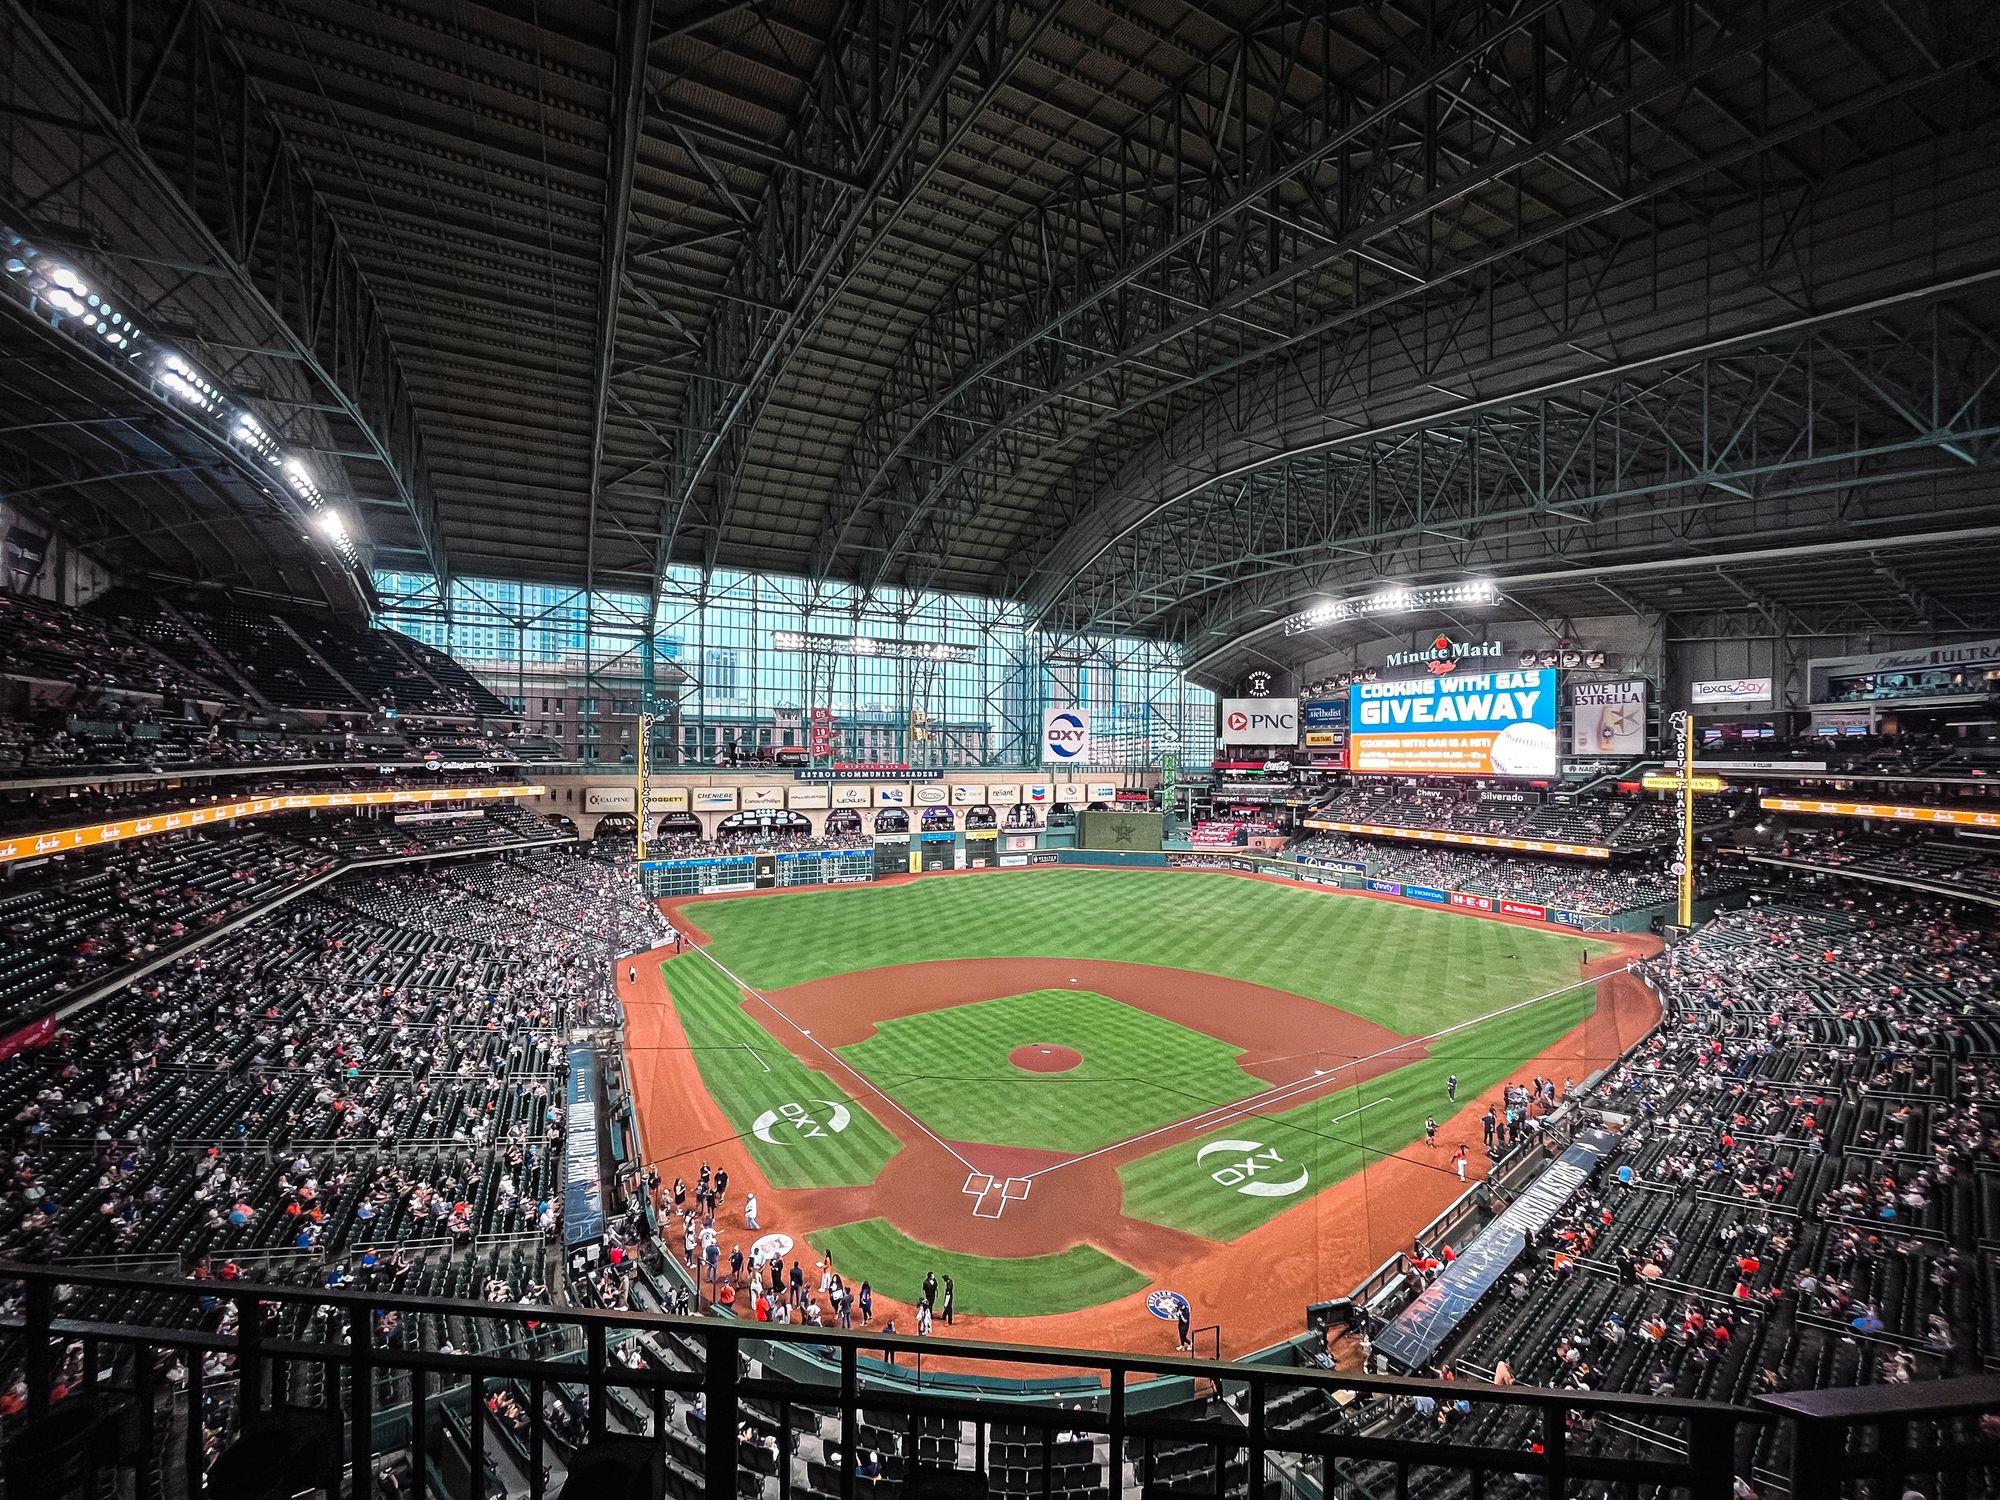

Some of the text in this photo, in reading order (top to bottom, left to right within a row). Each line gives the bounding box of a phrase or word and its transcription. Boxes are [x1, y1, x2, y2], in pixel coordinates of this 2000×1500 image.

[1386, 641, 1502, 668] Minute Maid
[1254, 679, 1265, 690] H
[1360, 671, 1541, 700] COOKING WITH GAS
[1613, 682, 1631, 694] TU
[1697, 680, 1766, 694] Texas Bay
[1360, 691, 1542, 725] GIVEAWAY
[1250, 714, 1293, 729] PNC
[1048, 730, 1085, 741] OXY
[815, 745, 824, 753] 21
[1676, 733, 1685, 767] ROOT
[1676, 770, 1685, 779] 4
[890, 789, 904, 798] slb
[992, 788, 1014, 796] reliant
[1416, 788, 1524, 802] Chevy Silverado
[1217, 795, 1240, 803] impact
[1246, 796, 1269, 804] impact
[1318, 861, 1356, 872] LEXUS
[1372, 882, 1394, 892] xfinity
[1414, 889, 1443, 899] HONDA
[778, 1102, 829, 1138] OXY
[568, 1153, 599, 1183] PARK
[1211, 1147, 1285, 1186] OXY
[1504, 1160, 1588, 1235] HOUSTON ASTROS
[1454, 1264, 1485, 1290] HOME
